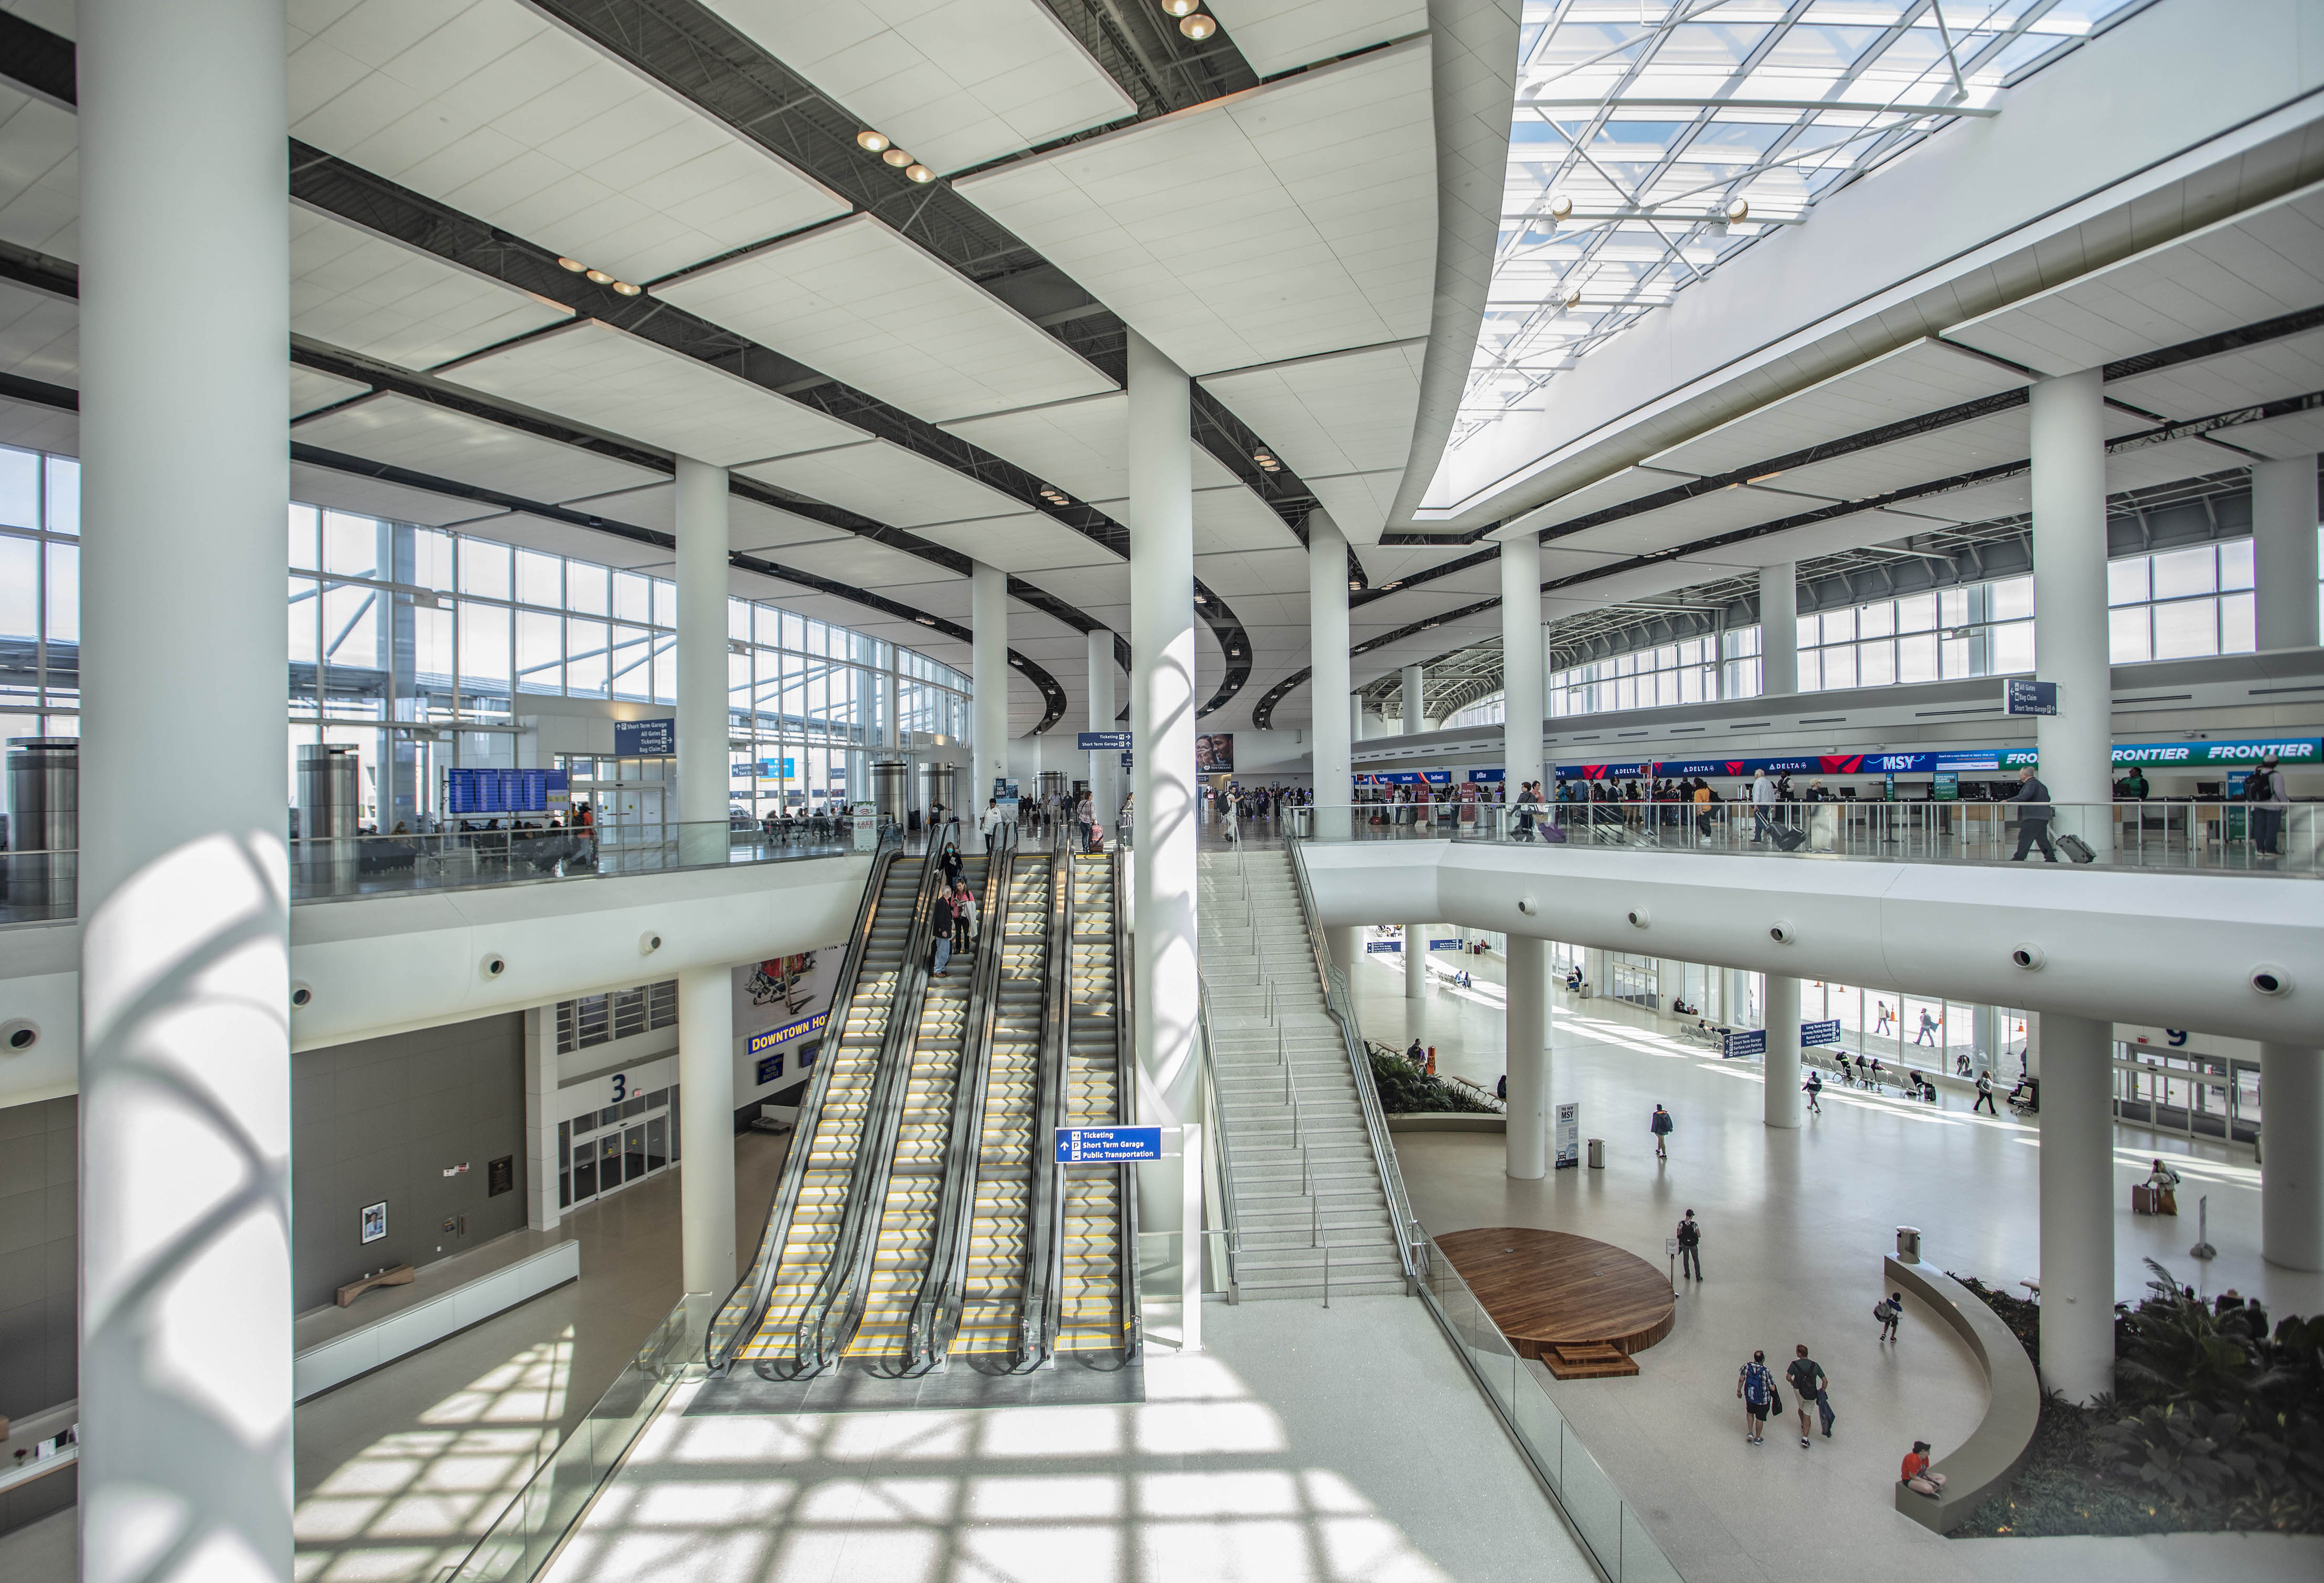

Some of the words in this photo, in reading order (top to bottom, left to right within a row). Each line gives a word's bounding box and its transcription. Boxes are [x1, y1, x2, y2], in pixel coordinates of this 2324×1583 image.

[2112, 748, 2189, 761] RONTIER
[2208, 743, 2314, 759] FRONTIER
[1883, 756, 1914, 770] MSY
[752, 1021, 809, 1051] DOWNTOWN
[763, 1070, 779, 1080] SHUTTLE
[612, 1074, 625, 1103] 3
[1561, 1110, 1574, 1120] MSY
[1105, 1150, 1154, 1159] Transportation
